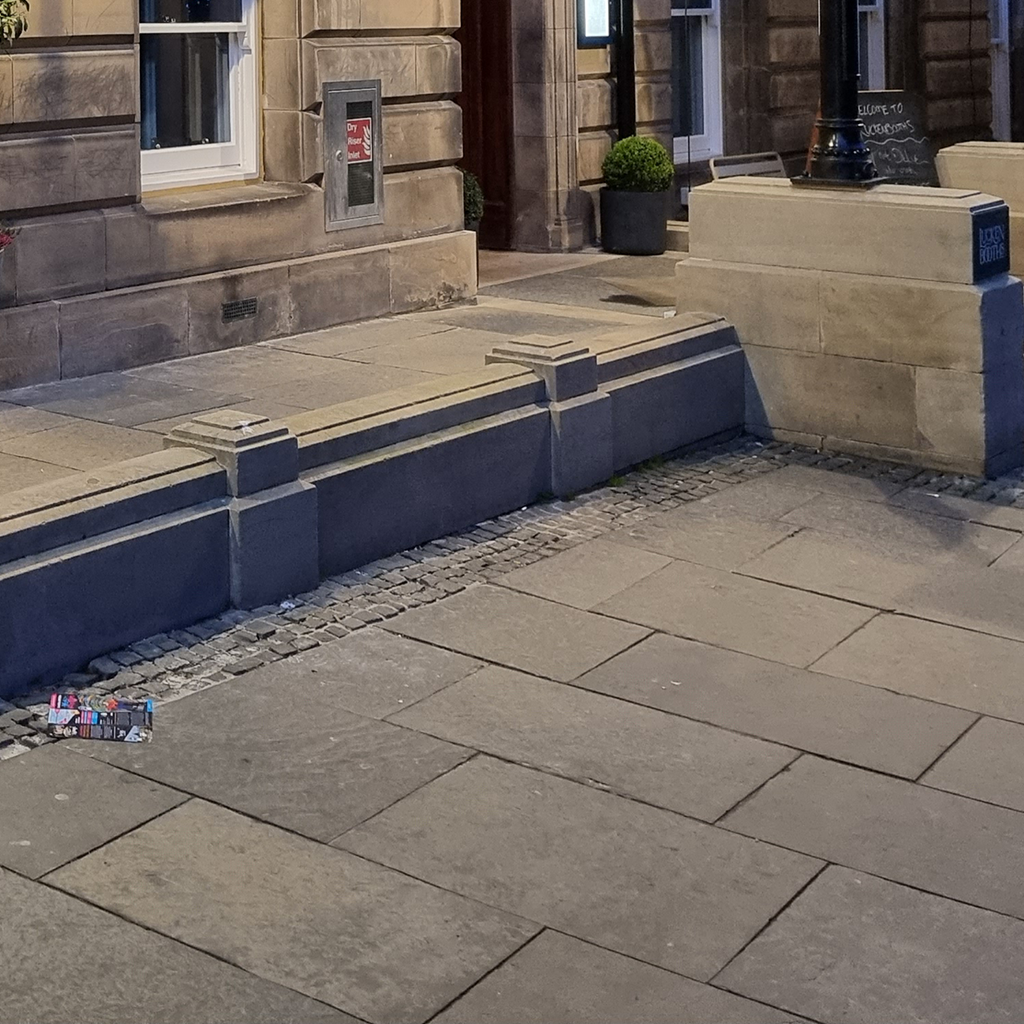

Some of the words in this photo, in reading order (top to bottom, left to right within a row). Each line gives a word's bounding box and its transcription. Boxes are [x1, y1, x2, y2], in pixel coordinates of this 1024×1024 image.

[858, 103, 889, 116] ELCOME
[890, 102, 903, 113] TO
[347, 123, 357, 133] Dry
[347, 137, 362, 145] Riser
[348, 151, 360, 159] Inlet
